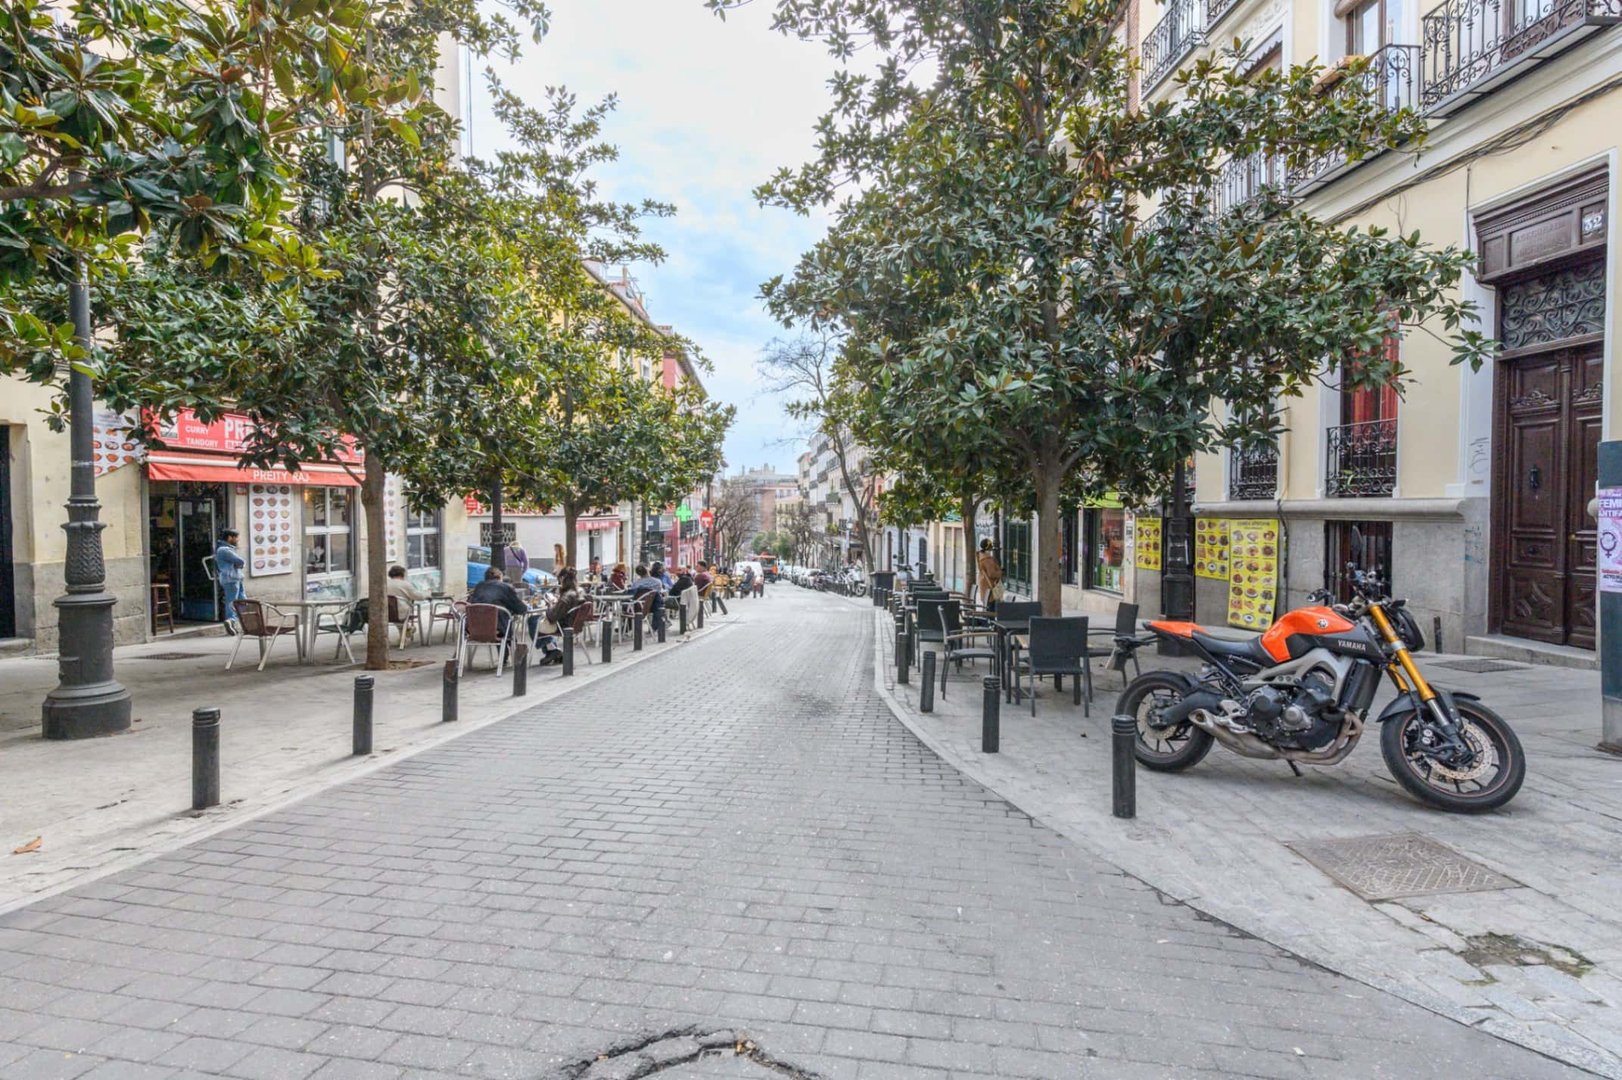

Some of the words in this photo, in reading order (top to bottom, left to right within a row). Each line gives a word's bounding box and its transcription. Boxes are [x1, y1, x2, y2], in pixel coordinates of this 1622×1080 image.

[185, 424, 209, 435] CURRY
[253, 470, 288, 481] PREITY
[292, 473, 310, 482] RAJ
[1337, 639, 1366, 651] YAMAHA
